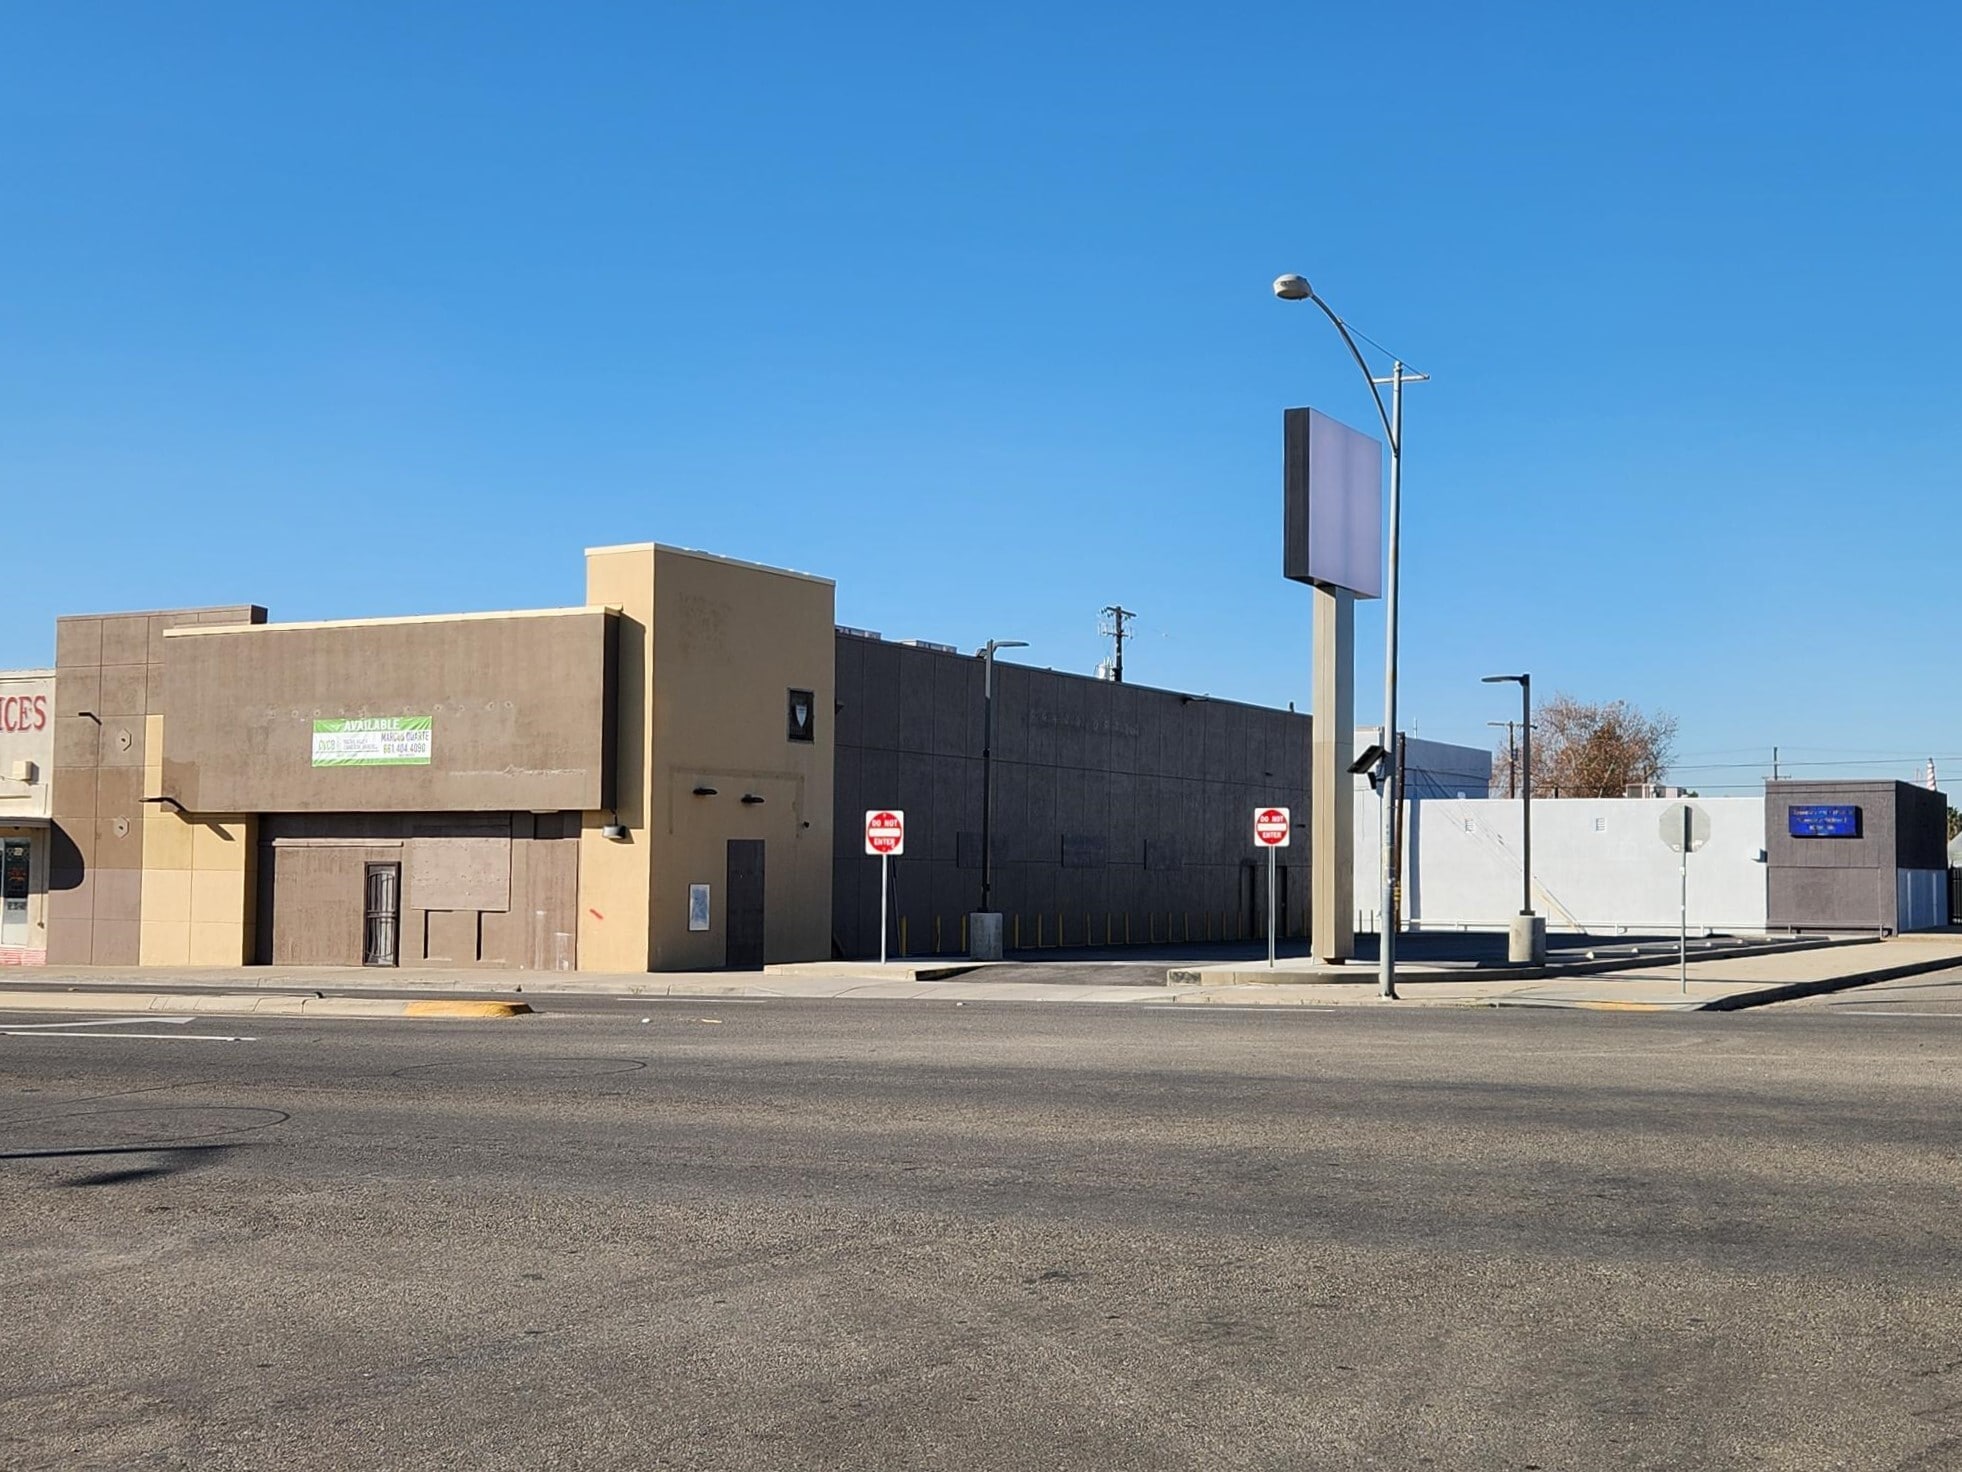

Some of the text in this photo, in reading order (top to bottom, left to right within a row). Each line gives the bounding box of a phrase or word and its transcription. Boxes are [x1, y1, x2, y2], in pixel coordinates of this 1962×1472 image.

[344, 719, 400, 732] AVAILABLE
[871, 819, 898, 828] DO NOT
[1260, 815, 1284, 823] DO NOT
[1262, 831, 1282, 839] ENTER
[874, 837, 896, 846] ENTER
